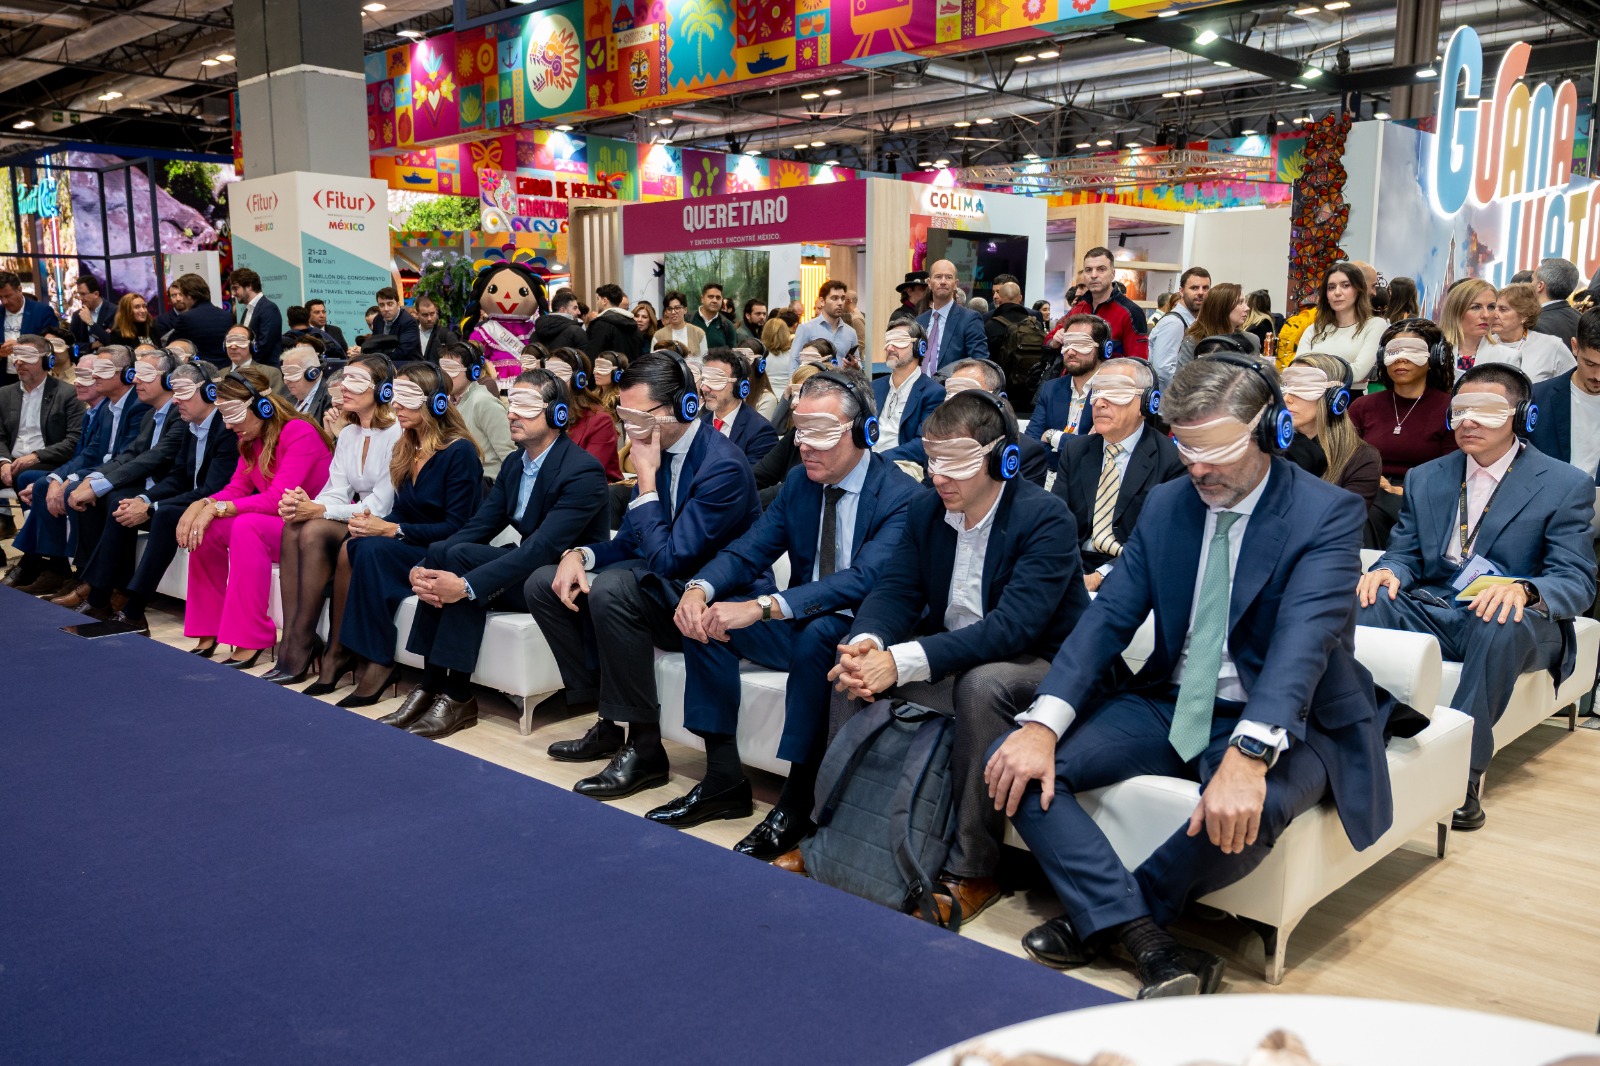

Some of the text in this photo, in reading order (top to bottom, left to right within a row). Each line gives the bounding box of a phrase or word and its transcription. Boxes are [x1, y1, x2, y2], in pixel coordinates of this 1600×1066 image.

[930, 191, 985, 214] COLIMA
[683, 196, 788, 234] QUERÉTARO
[308, 248, 327, 257] 21-23
[308, 256, 336, 265] Ene/Jan
